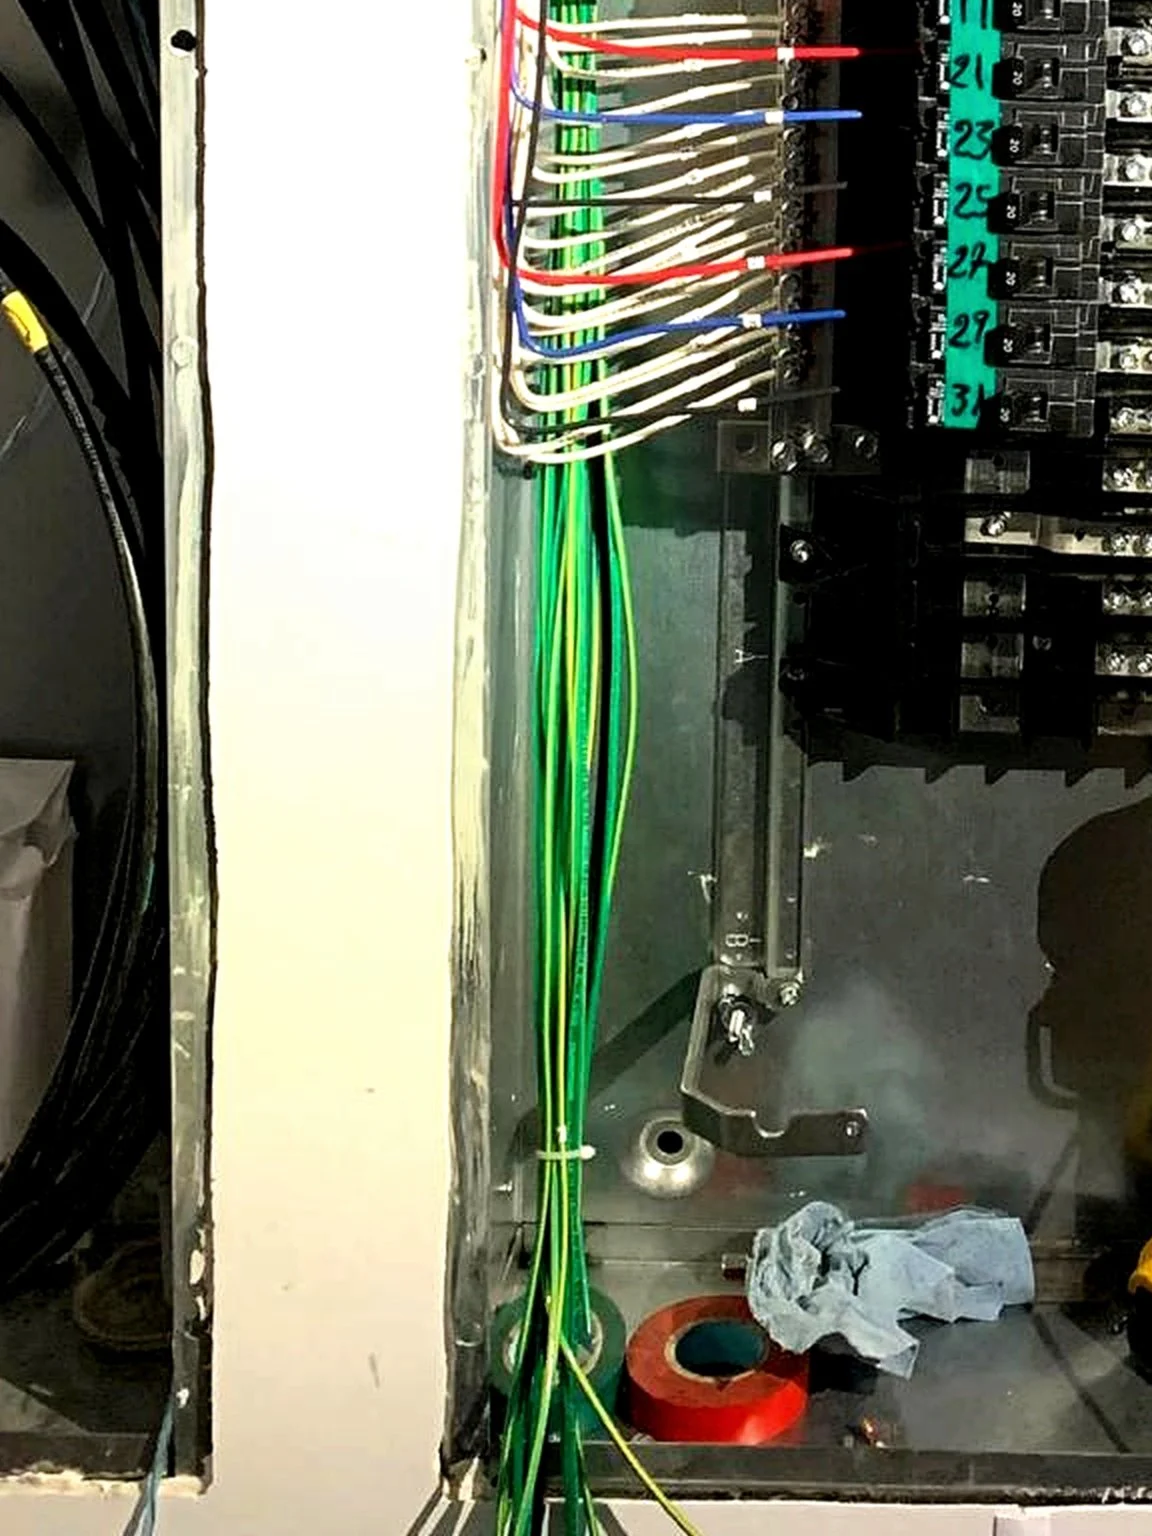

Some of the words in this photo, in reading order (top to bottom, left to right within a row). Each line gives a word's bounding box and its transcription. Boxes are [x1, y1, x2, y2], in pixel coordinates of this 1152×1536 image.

[1012, 2, 1022, 17] 20
[950, 55, 983, 88] 21
[1013, 71, 1023, 86] 20
[954, 120, 994, 159] 23
[1010, 138, 1019, 153] 20
[1007, 205, 1017, 220] 20
[1006, 271, 1016, 286] 20
[949, 310, 989, 348] 29
[1004, 338, 1012, 353] 20
[1000, 407, 1009, 422] 20
